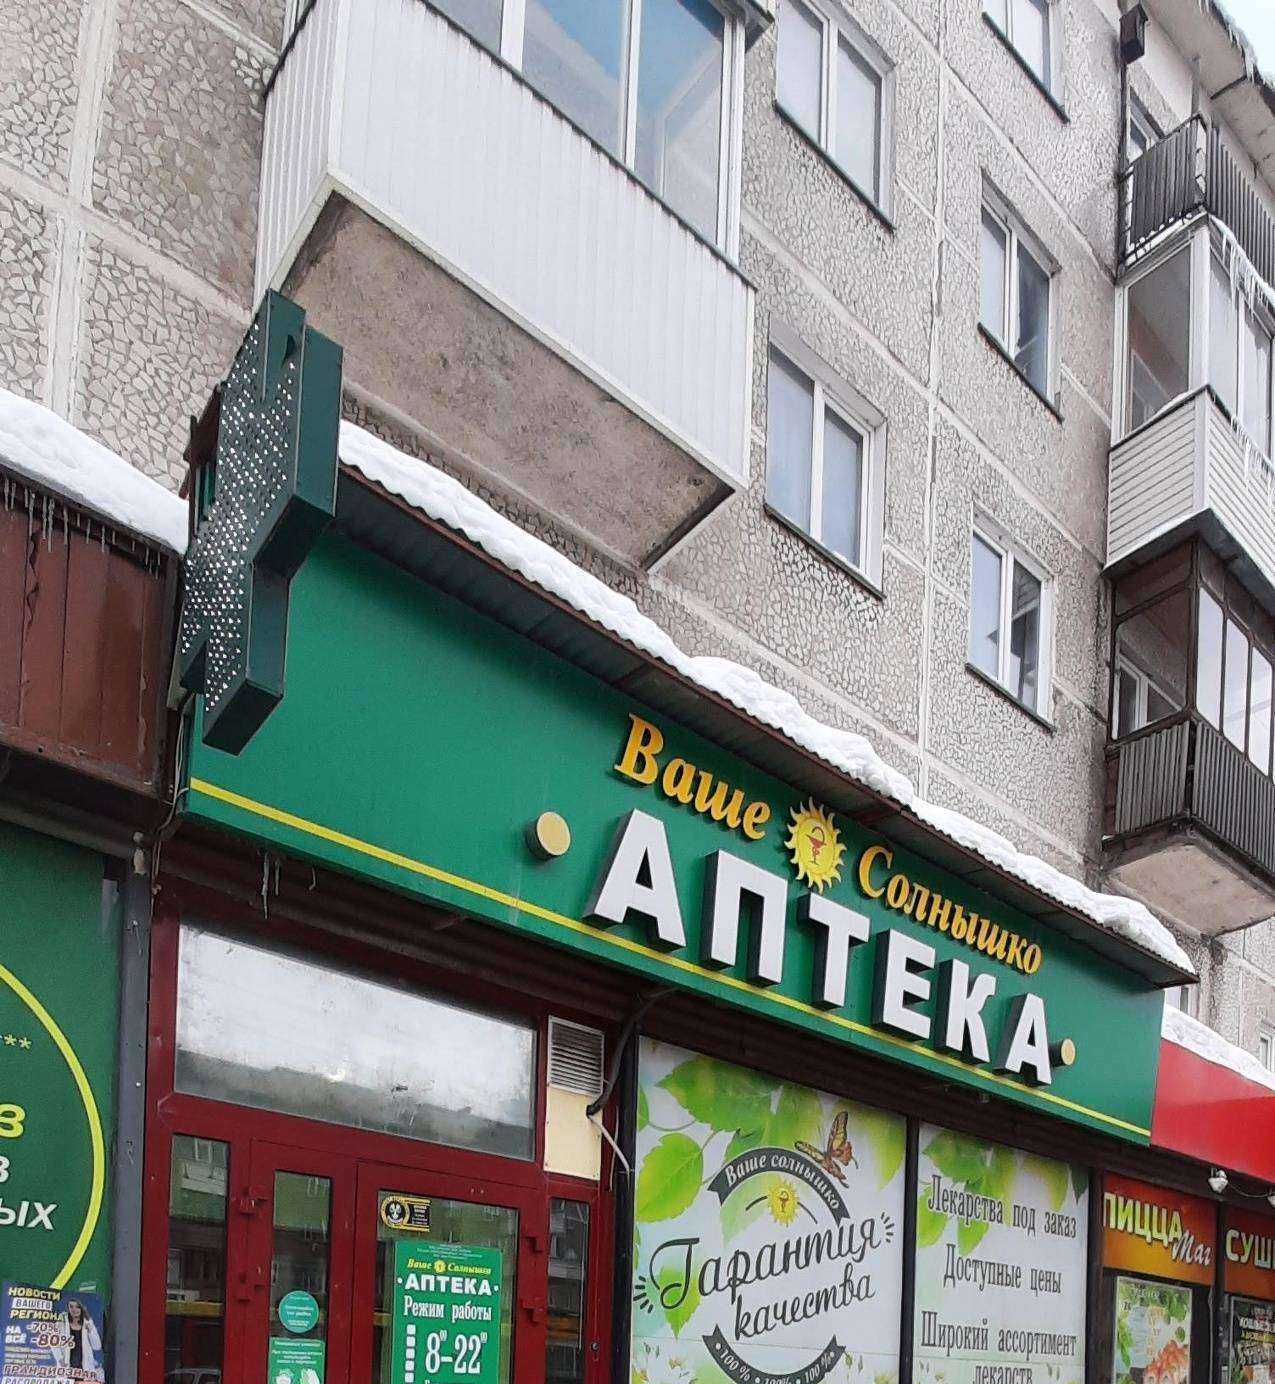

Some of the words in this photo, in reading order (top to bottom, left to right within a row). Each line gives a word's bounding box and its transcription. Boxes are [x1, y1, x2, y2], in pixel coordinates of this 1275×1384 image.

[614, 713, 772, 840] Ваше
[858, 845, 1043, 975] Солнышко
[588, 808, 1053, 1087] АПТЕКА
[724, 1154, 767, 1187] Ваше
[770, 1154, 840, 1209] солнышко
[928, 1174, 1004, 1227] Лекарства
[1013, 1203, 1036, 1236] под
[1044, 1210, 1077, 1239] заказ
[1103, 1192, 1183, 1248] ПИЦЦА
[404, 1273, 492, 1296] АПТЕКА
[650, 1216, 882, 1310] Гарантия
[943, 1243, 1022, 1292] Доступные
[1030, 1267, 1062, 1297] цены
[8, 1286, 61, 1301] НОВОСТИ
[10, 1310, 65, 1322] РЕГИОНА
[404, 1295, 445, 1319] Режим
[452, 1301, 492, 1323] работы
[733, 1262, 876, 1341] качества
[6, 1325, 21, 1335] НА
[921, 1310, 989, 1357] Широкий
[998, 1328, 1077, 1361] ассортимент
